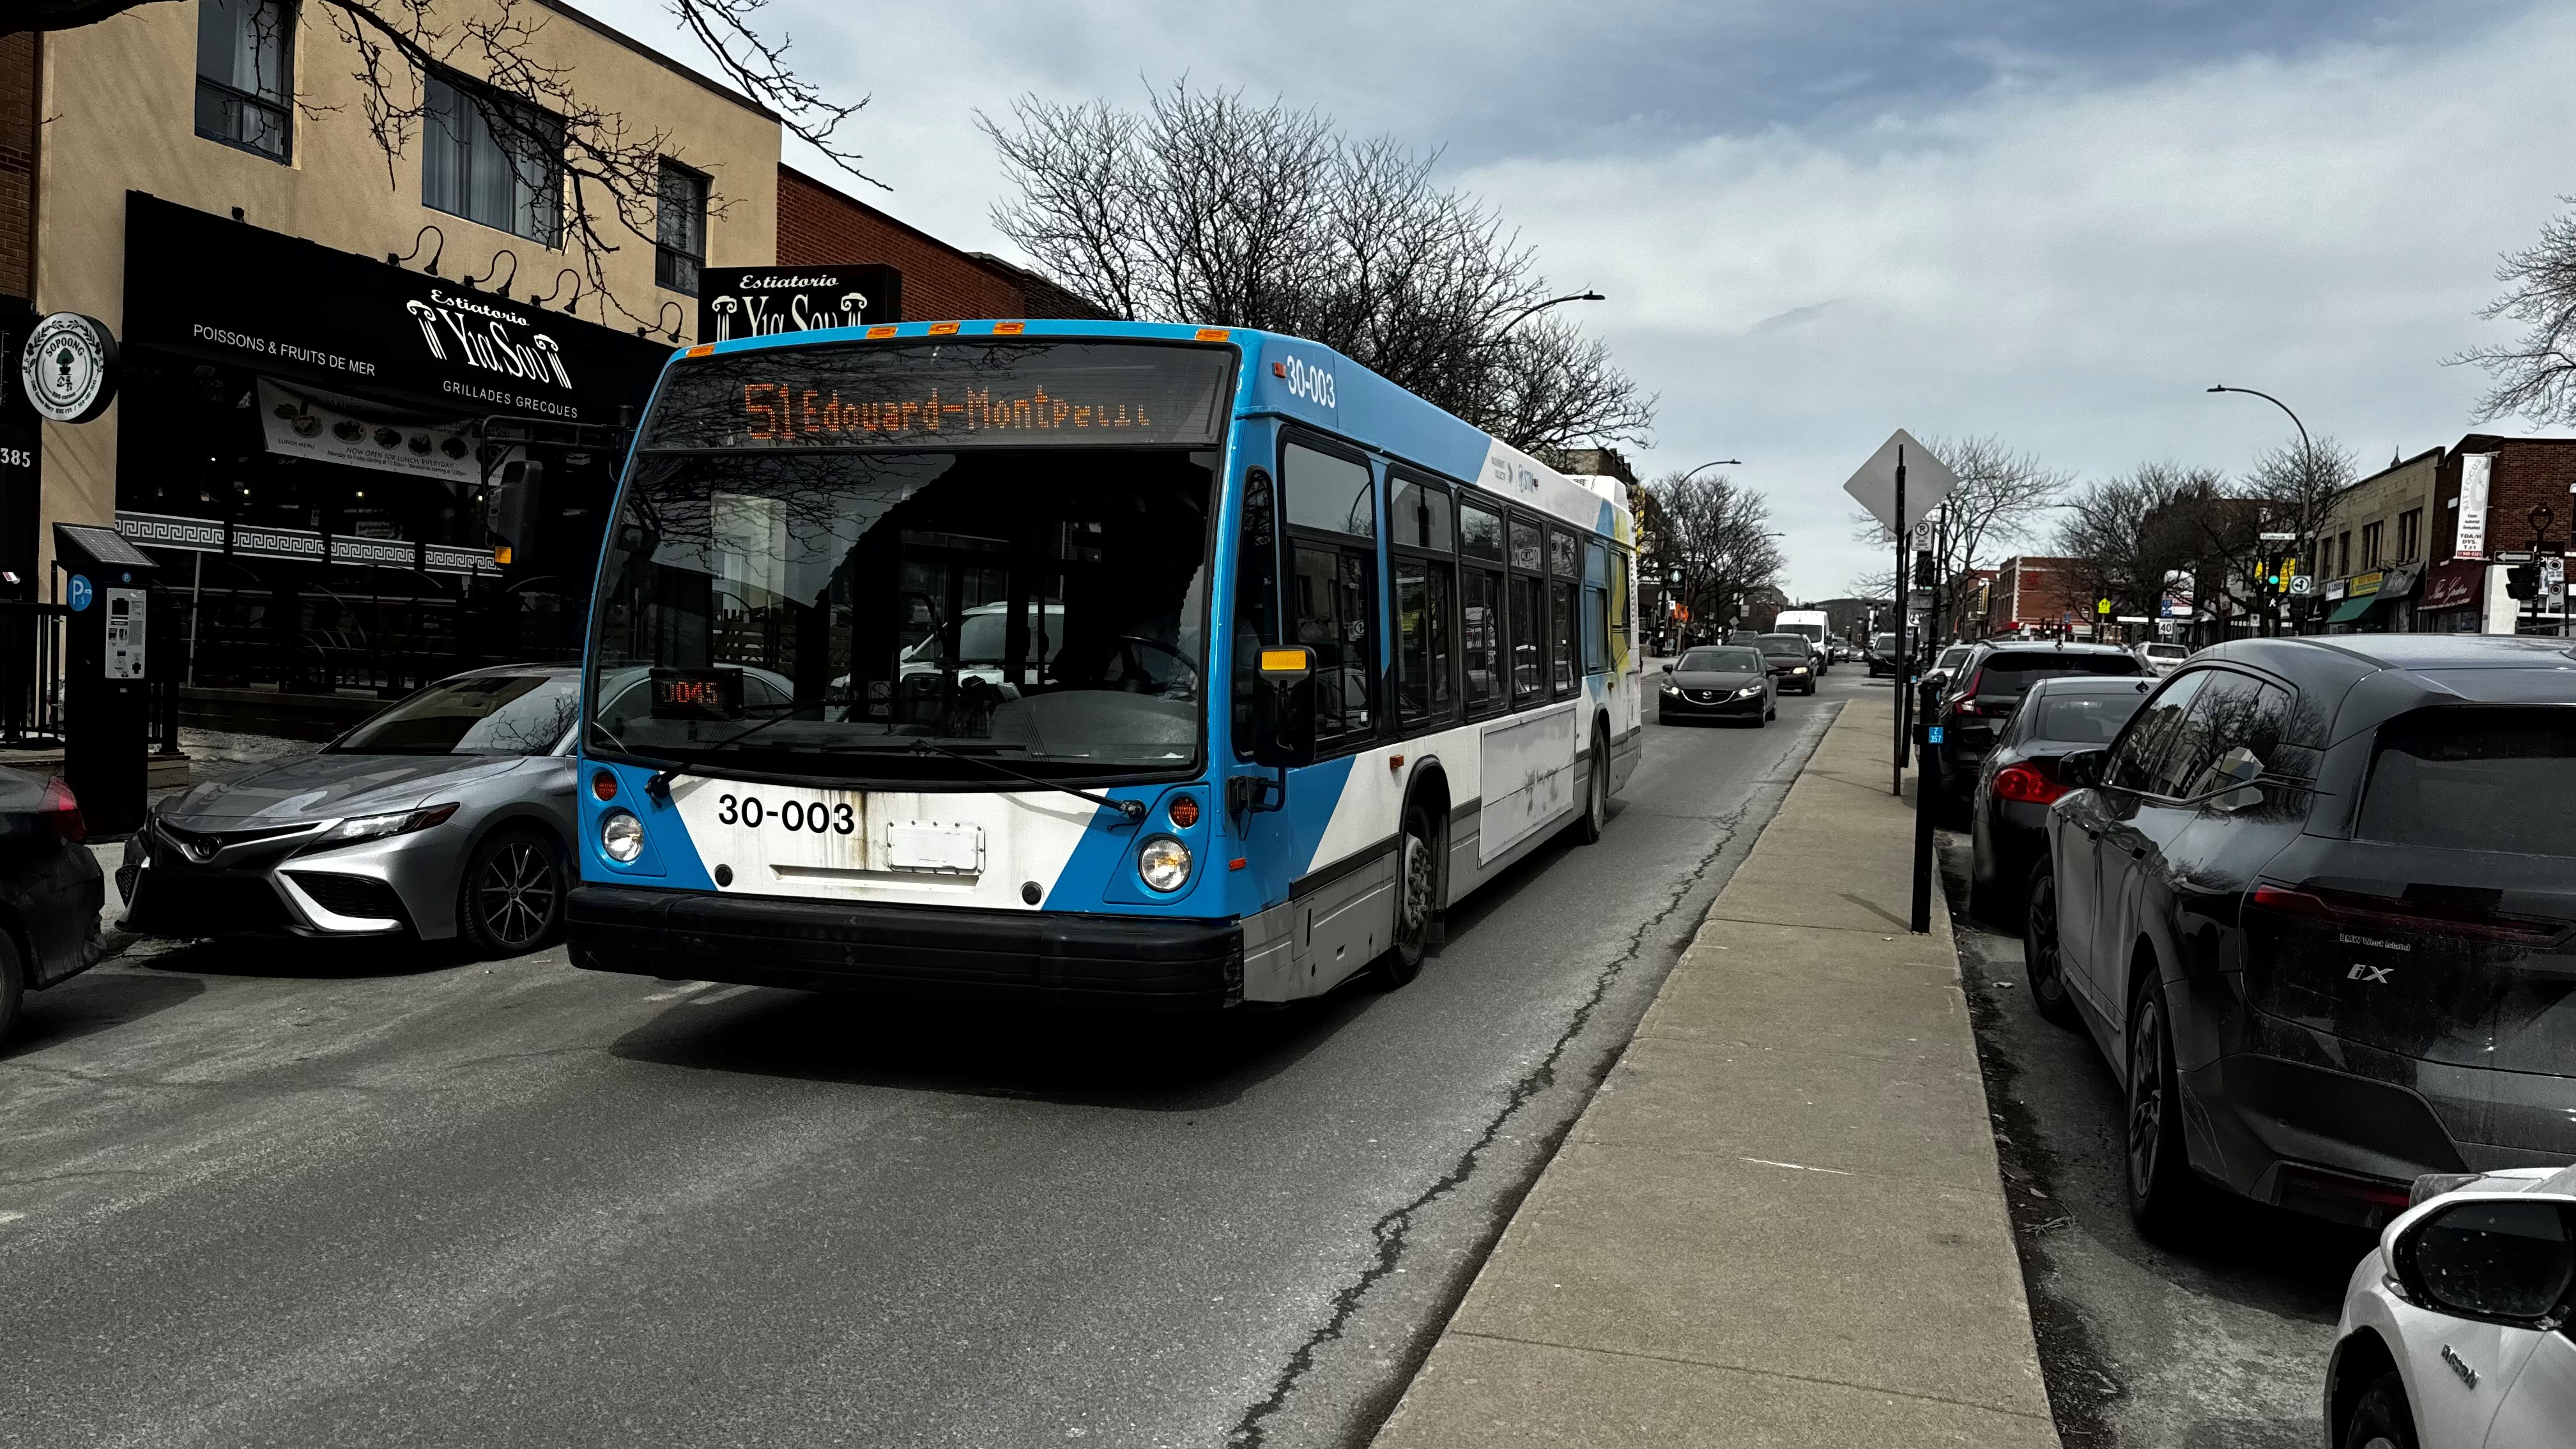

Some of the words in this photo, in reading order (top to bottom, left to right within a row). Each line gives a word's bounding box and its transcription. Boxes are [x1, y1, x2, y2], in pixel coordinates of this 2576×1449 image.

[739, 274, 839, 289] Estiatorio
[431, 289, 530, 326] Estiatorio
[45, 337, 85, 357] SOPOONG
[194, 323, 264, 352] POISSONS
[268, 341, 277, 355] &
[280, 343, 326, 365] FRUITS
[329, 355, 346, 370] DE
[349, 359, 376, 377] MER
[1287, 355, 1336, 409] 30-003
[443, 380, 511, 405] GRILLADES
[516, 395, 578, 418] GRECQUES
[744, 383, 796, 440] 51
[0, 447, 31, 468] 385
[346, 447, 364, 455] NOW
[365, 450, 383, 458] OPEN
[397, 456, 419, 464] LUNCH
[2463, 458, 2482, 491] FOCUS
[2160, 623, 2172, 632] 40
[1930, 735, 1942, 743] 357
[718, 793, 855, 835] 30-003
[2339, 933, 2362, 944] BMW
[2362, 937, 2384, 947] West
[2384, 940, 2411, 951] Island
[2347, 963, 2395, 984] iX
